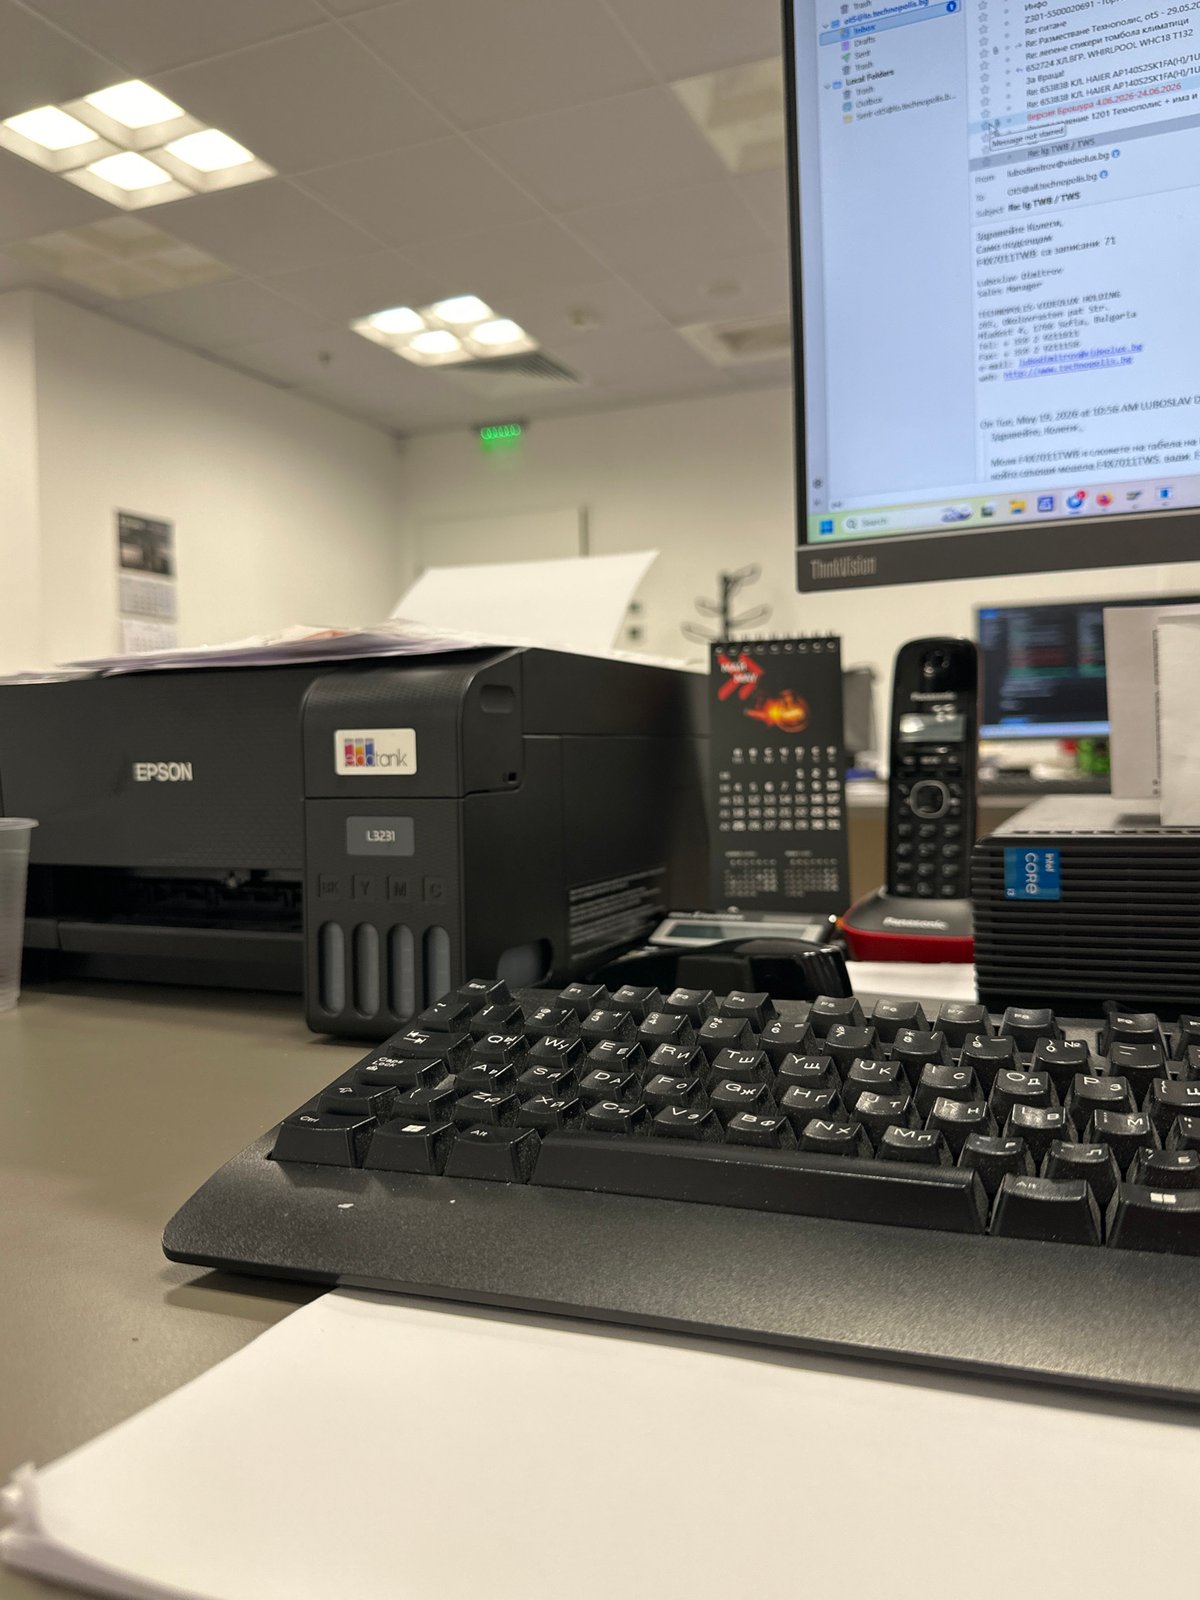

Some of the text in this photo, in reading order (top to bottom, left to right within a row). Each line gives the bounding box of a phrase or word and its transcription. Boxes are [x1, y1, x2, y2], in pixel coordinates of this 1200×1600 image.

[1024, 0, 1048, 11] Инфо
[1039, 20, 1067, 32] питане
[854, 36, 876, 47] Drafts
[1026, 36, 1037, 47] Re:
[1039, 25, 1090, 44] Разместване
[1026, 49, 1037, 60] Re:
[1070, 37, 1103, 50] стикери
[1105, 28, 1140, 43] томбола
[1142, 19, 1189, 35] климатици
[1088, 40, 1137, 59] WHIRLPOOL
[1140, 33, 1171, 48] WHC18
[1173, 29, 1193, 41] T132
[855, 50, 871, 59] Sent
[855, 61, 874, 71] Trash
[846, 69, 894, 86] Local Folders
[1086, 70, 1111, 84] HAIER
[1086, 82, 1111, 96] HAIER
[856, 97, 882, 109] Outbox
[1092, 108, 1110, 120] 1201
[1113, 97, 1162, 116] Технополис
[810, 555, 877, 579] ThinkVision
[133, 762, 193, 783] EPSON
[367, 830, 396, 842] L3231
[300, 1115, 319, 1123] Ctrl
